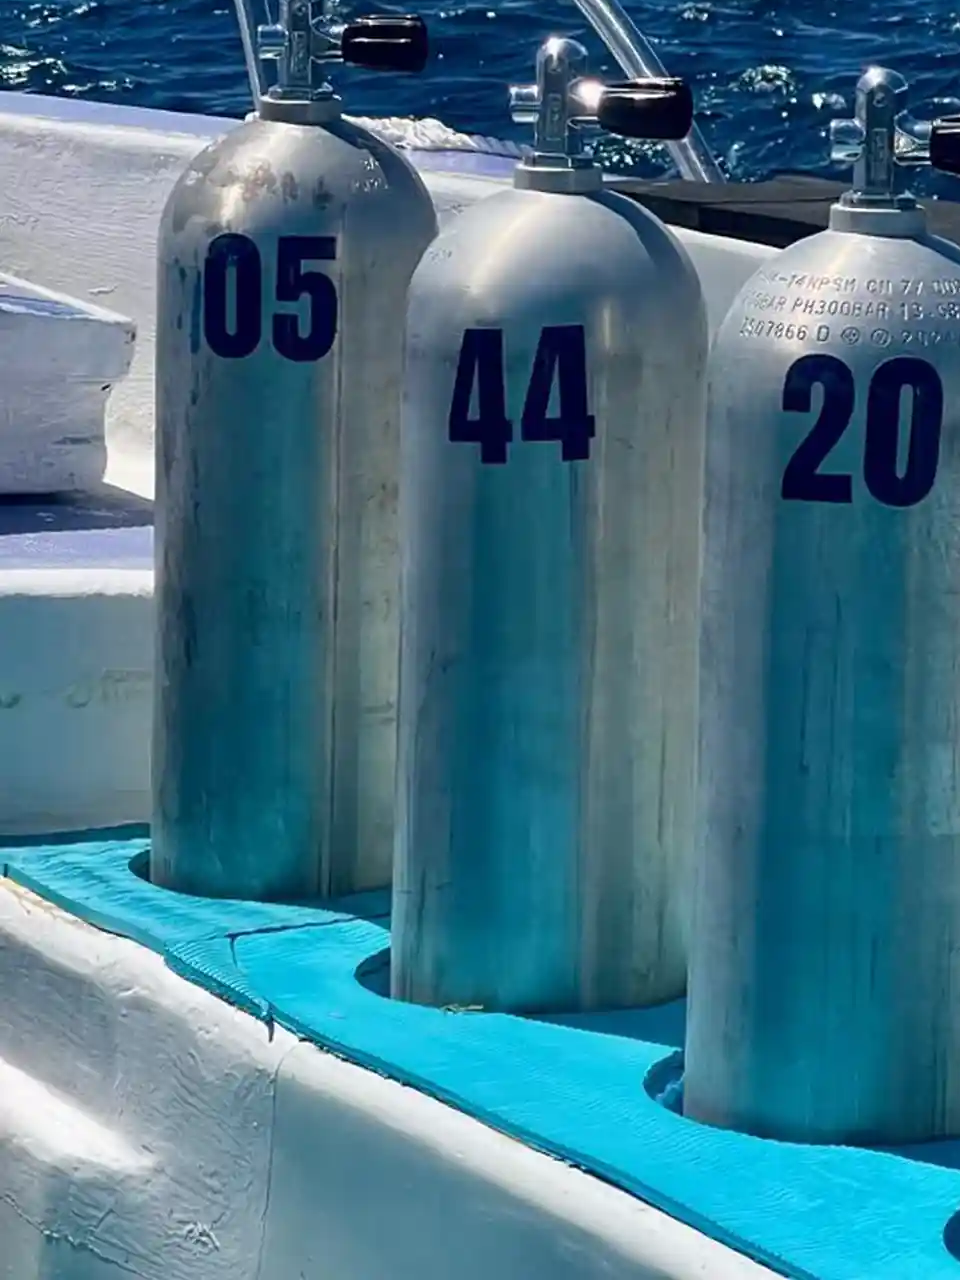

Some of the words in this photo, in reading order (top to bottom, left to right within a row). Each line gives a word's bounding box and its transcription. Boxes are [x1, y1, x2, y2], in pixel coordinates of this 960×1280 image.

[203, 233, 338, 362] 05
[448, 324, 596, 465] 44
[780, 354, 944, 507] 20
